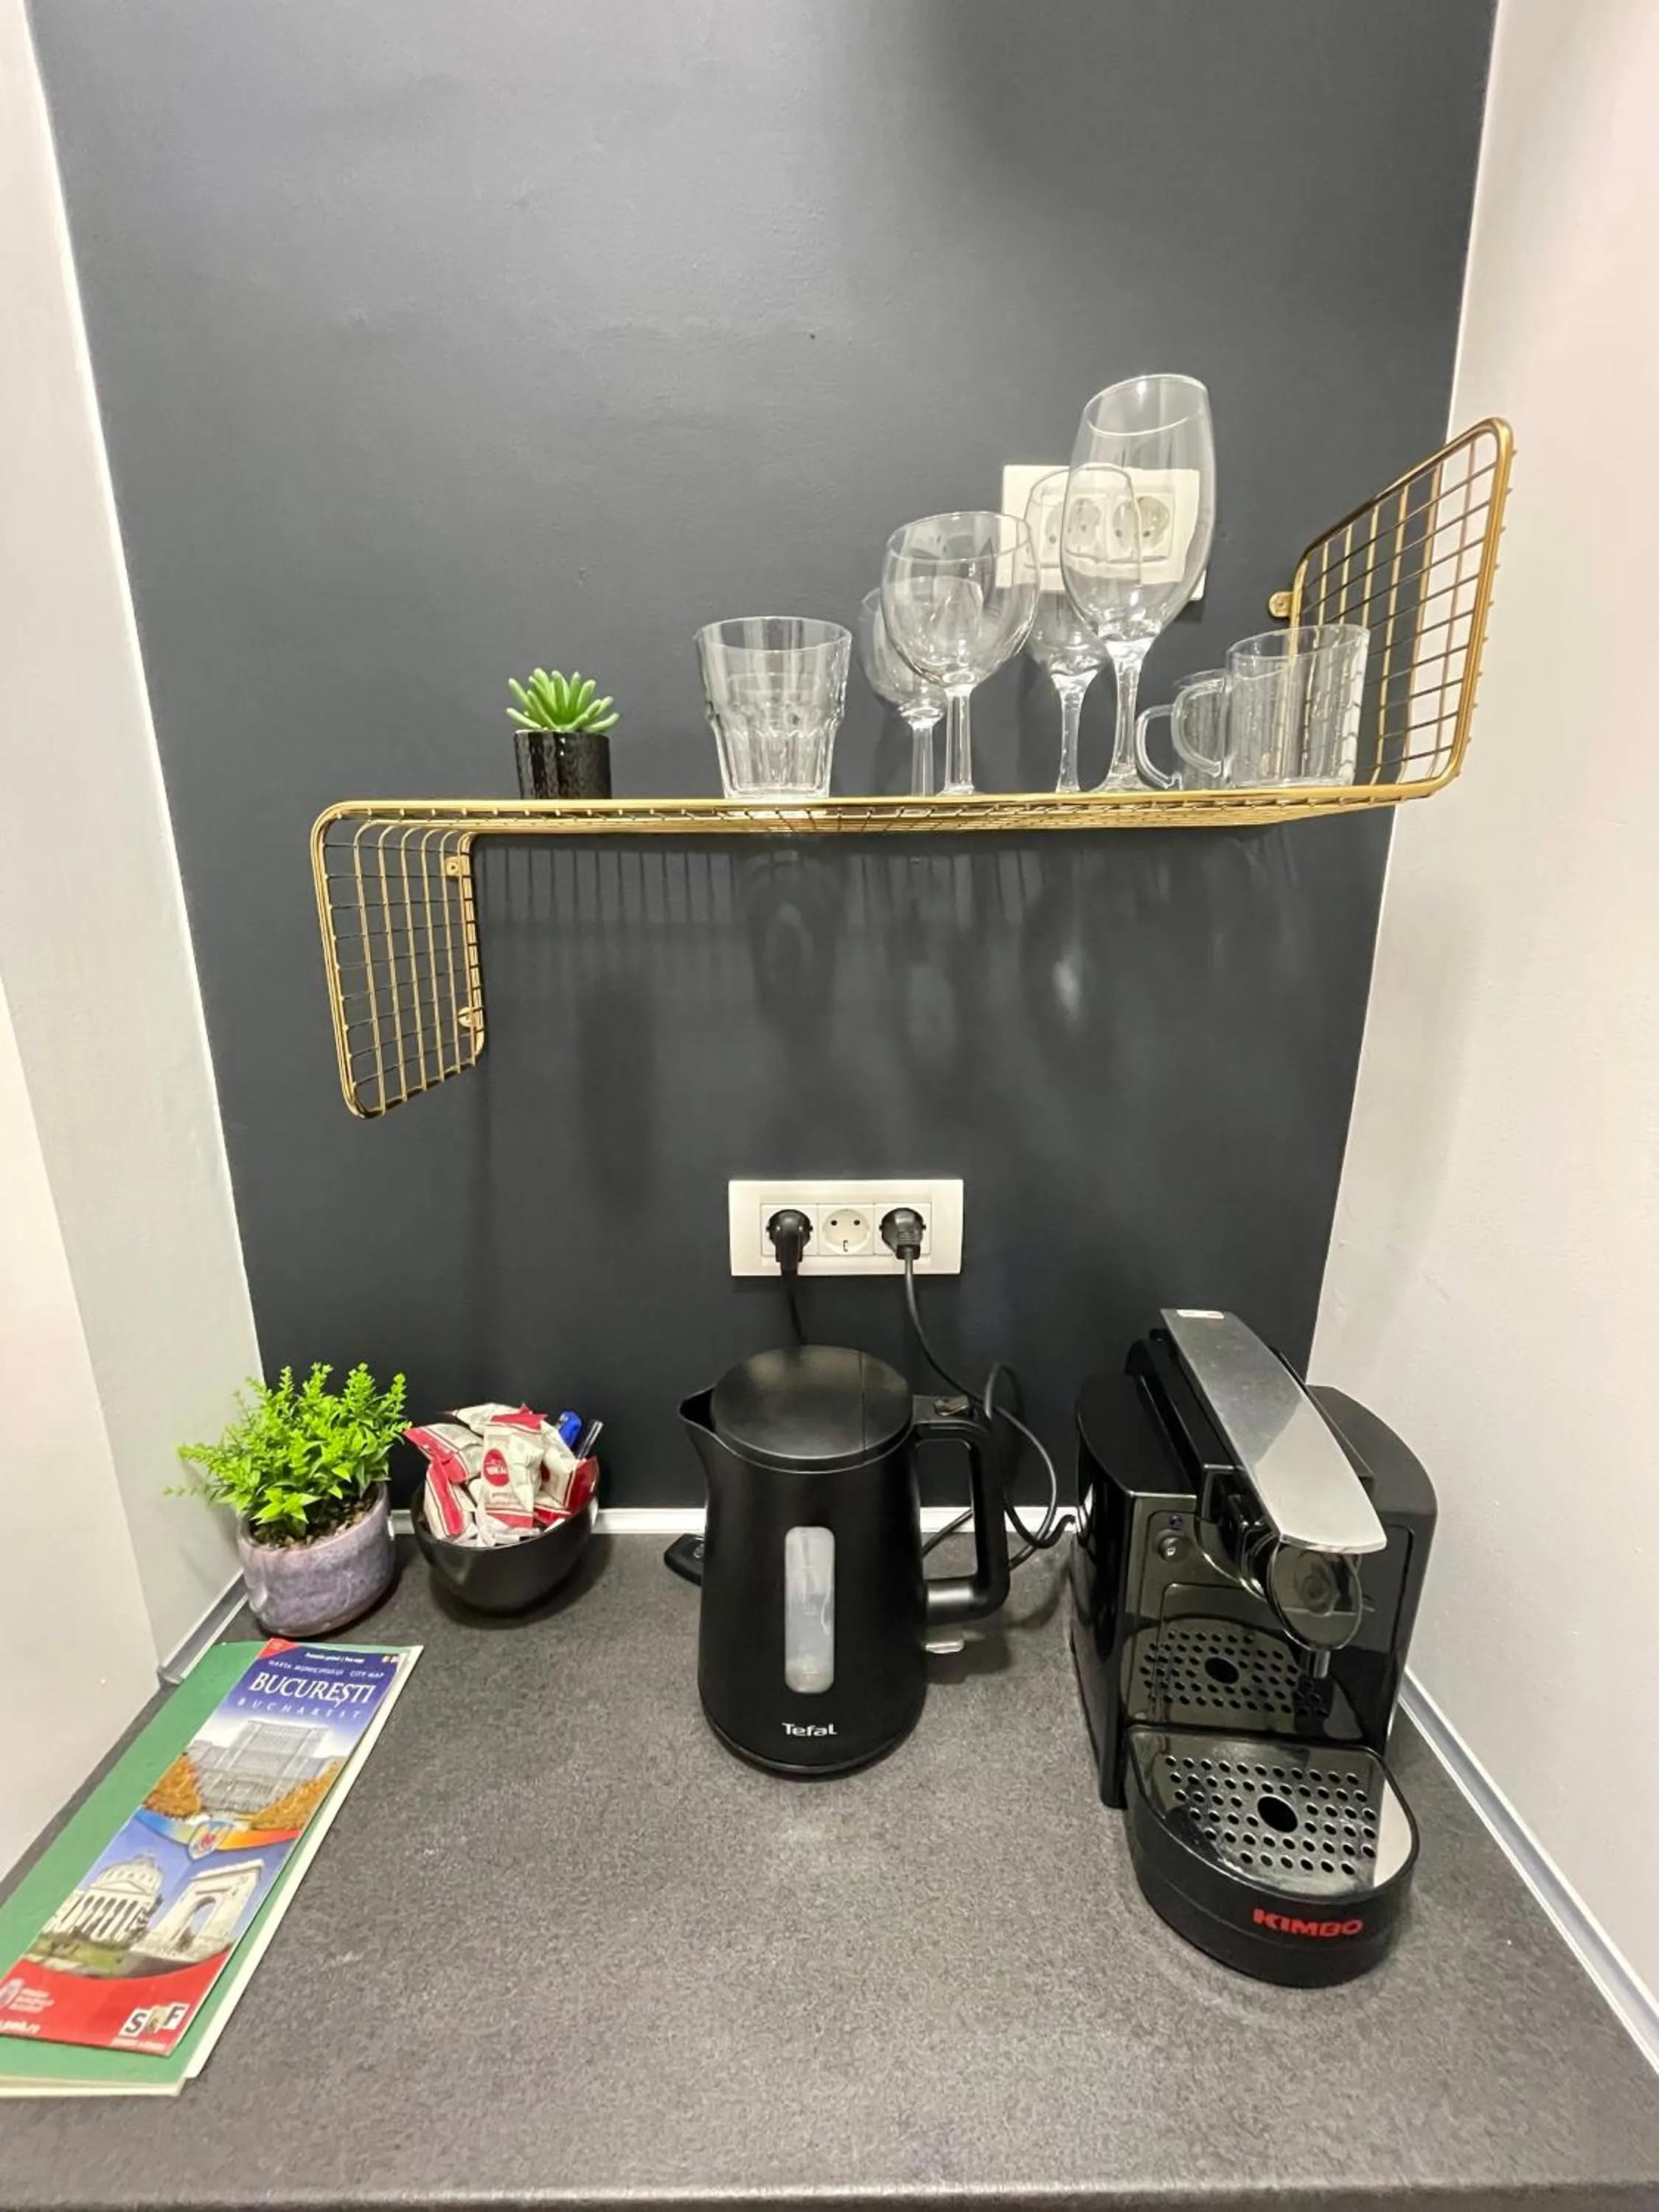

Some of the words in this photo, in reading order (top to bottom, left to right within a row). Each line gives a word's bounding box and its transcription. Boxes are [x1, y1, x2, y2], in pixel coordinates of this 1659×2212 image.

[237, 1697, 362, 1719] BUCHAREST
[782, 1722, 838, 1736] Tefal
[1253, 1908, 1363, 1937] KIMBO
